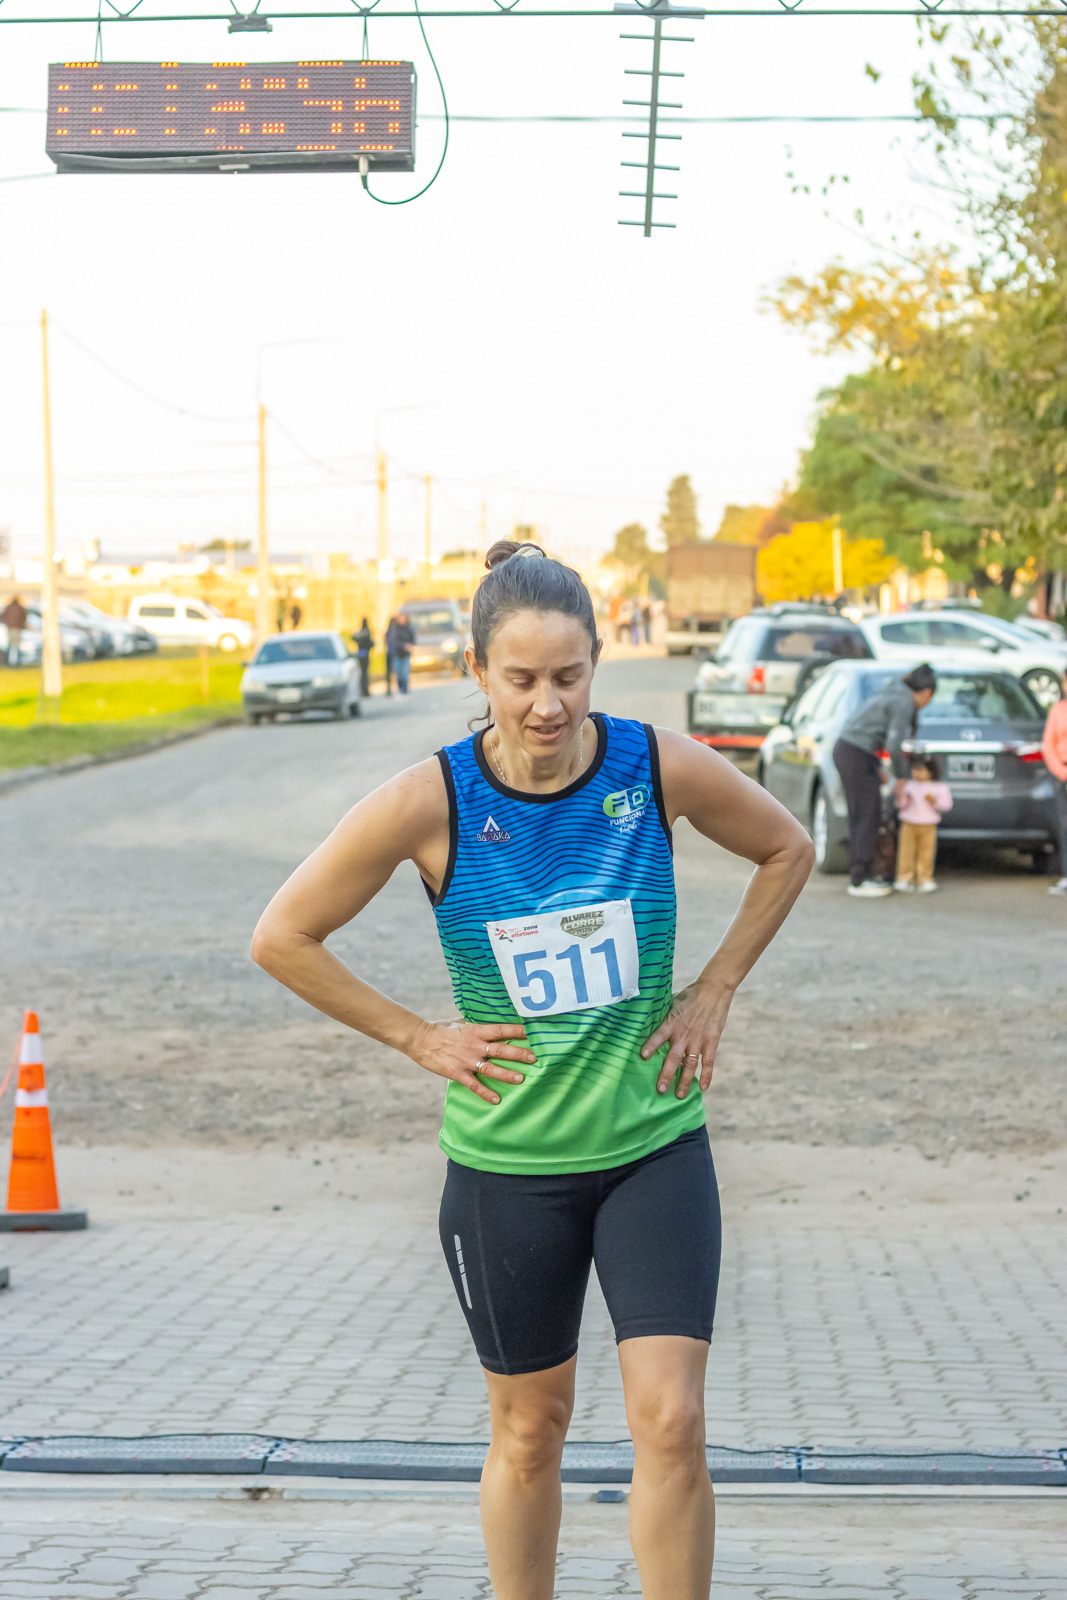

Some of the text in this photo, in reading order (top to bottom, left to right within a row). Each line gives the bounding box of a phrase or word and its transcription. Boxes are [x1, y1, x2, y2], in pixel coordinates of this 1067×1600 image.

[560, 910, 604, 925] ALVAREZ
[563, 918, 604, 931] CORRE
[512, 937, 624, 1012] 511
